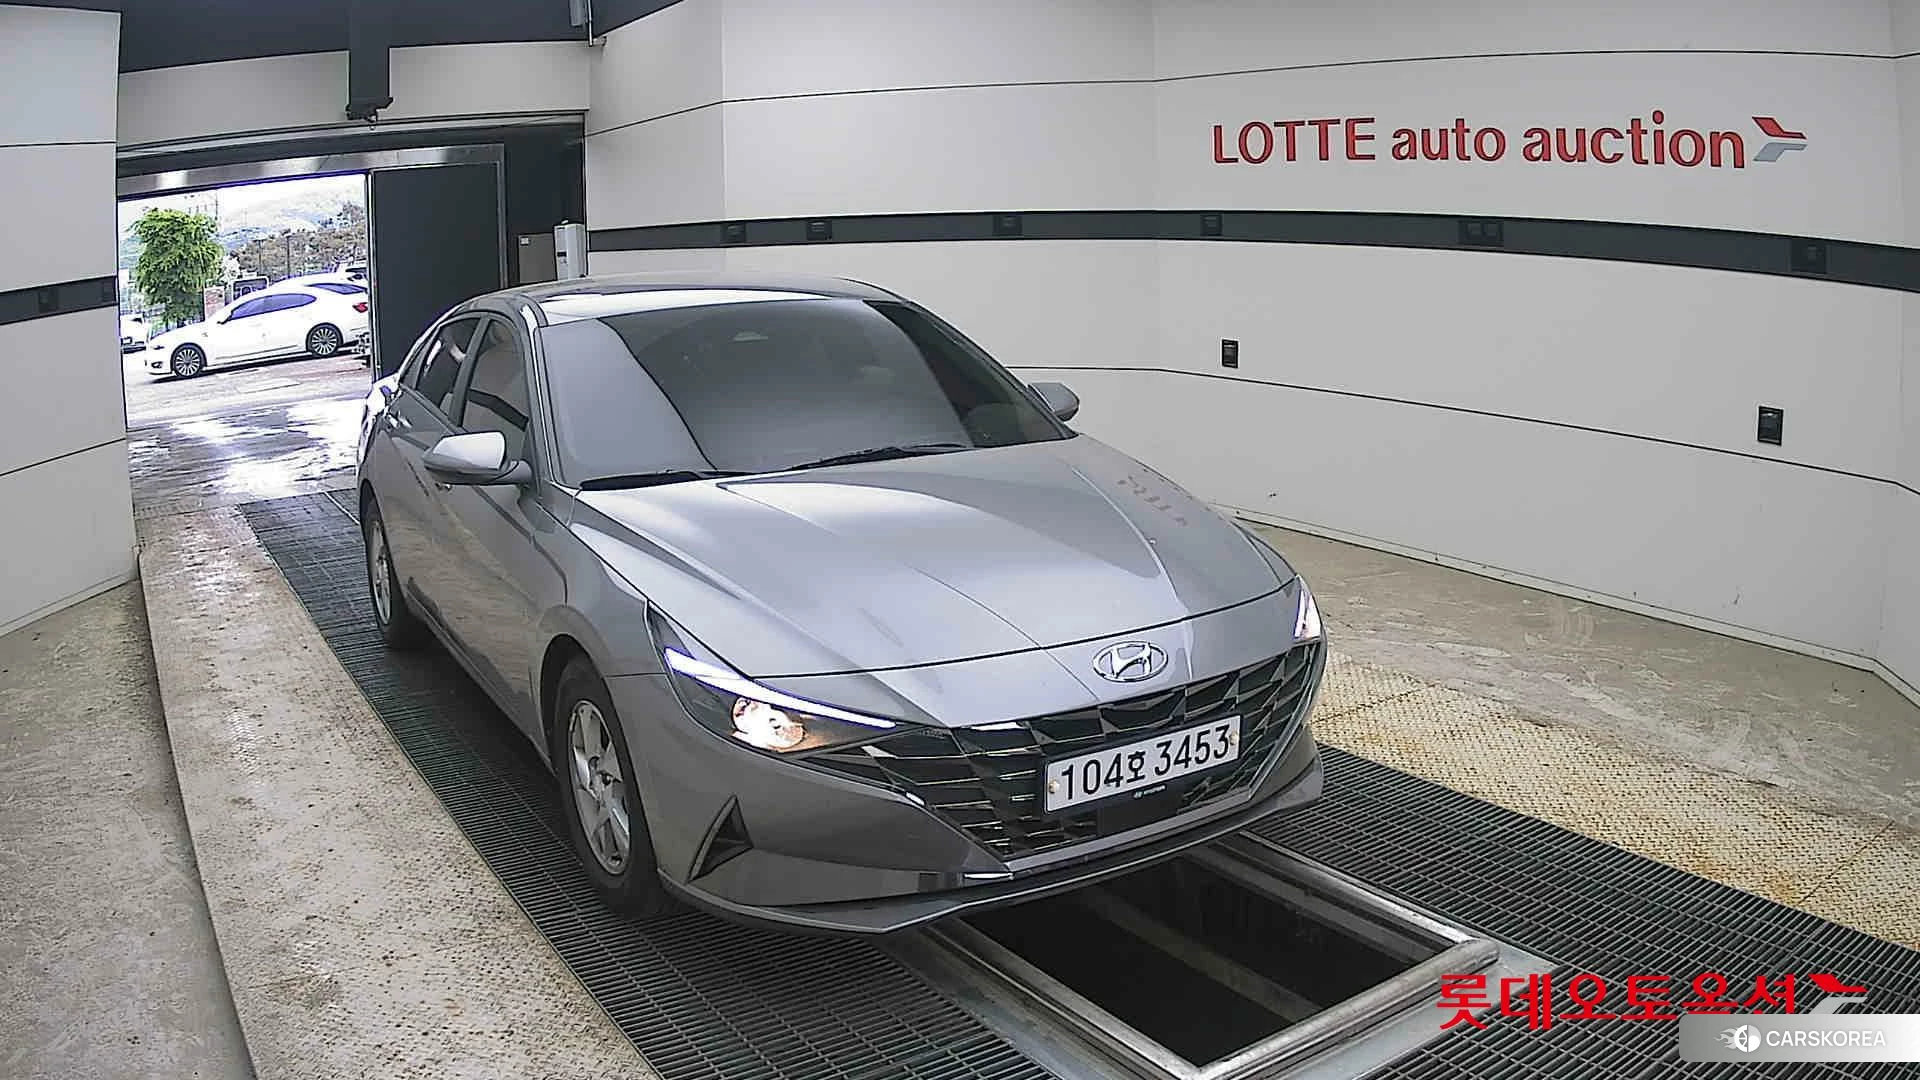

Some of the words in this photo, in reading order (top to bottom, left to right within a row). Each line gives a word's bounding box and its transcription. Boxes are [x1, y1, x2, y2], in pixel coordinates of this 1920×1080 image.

[1212, 117, 1376, 164] LOTTE
[1392, 117, 1506, 160] auto
[1522, 111, 1746, 169] auction
[1061, 751, 1146, 800] 104호
[1154, 724, 1231, 777] 3453
